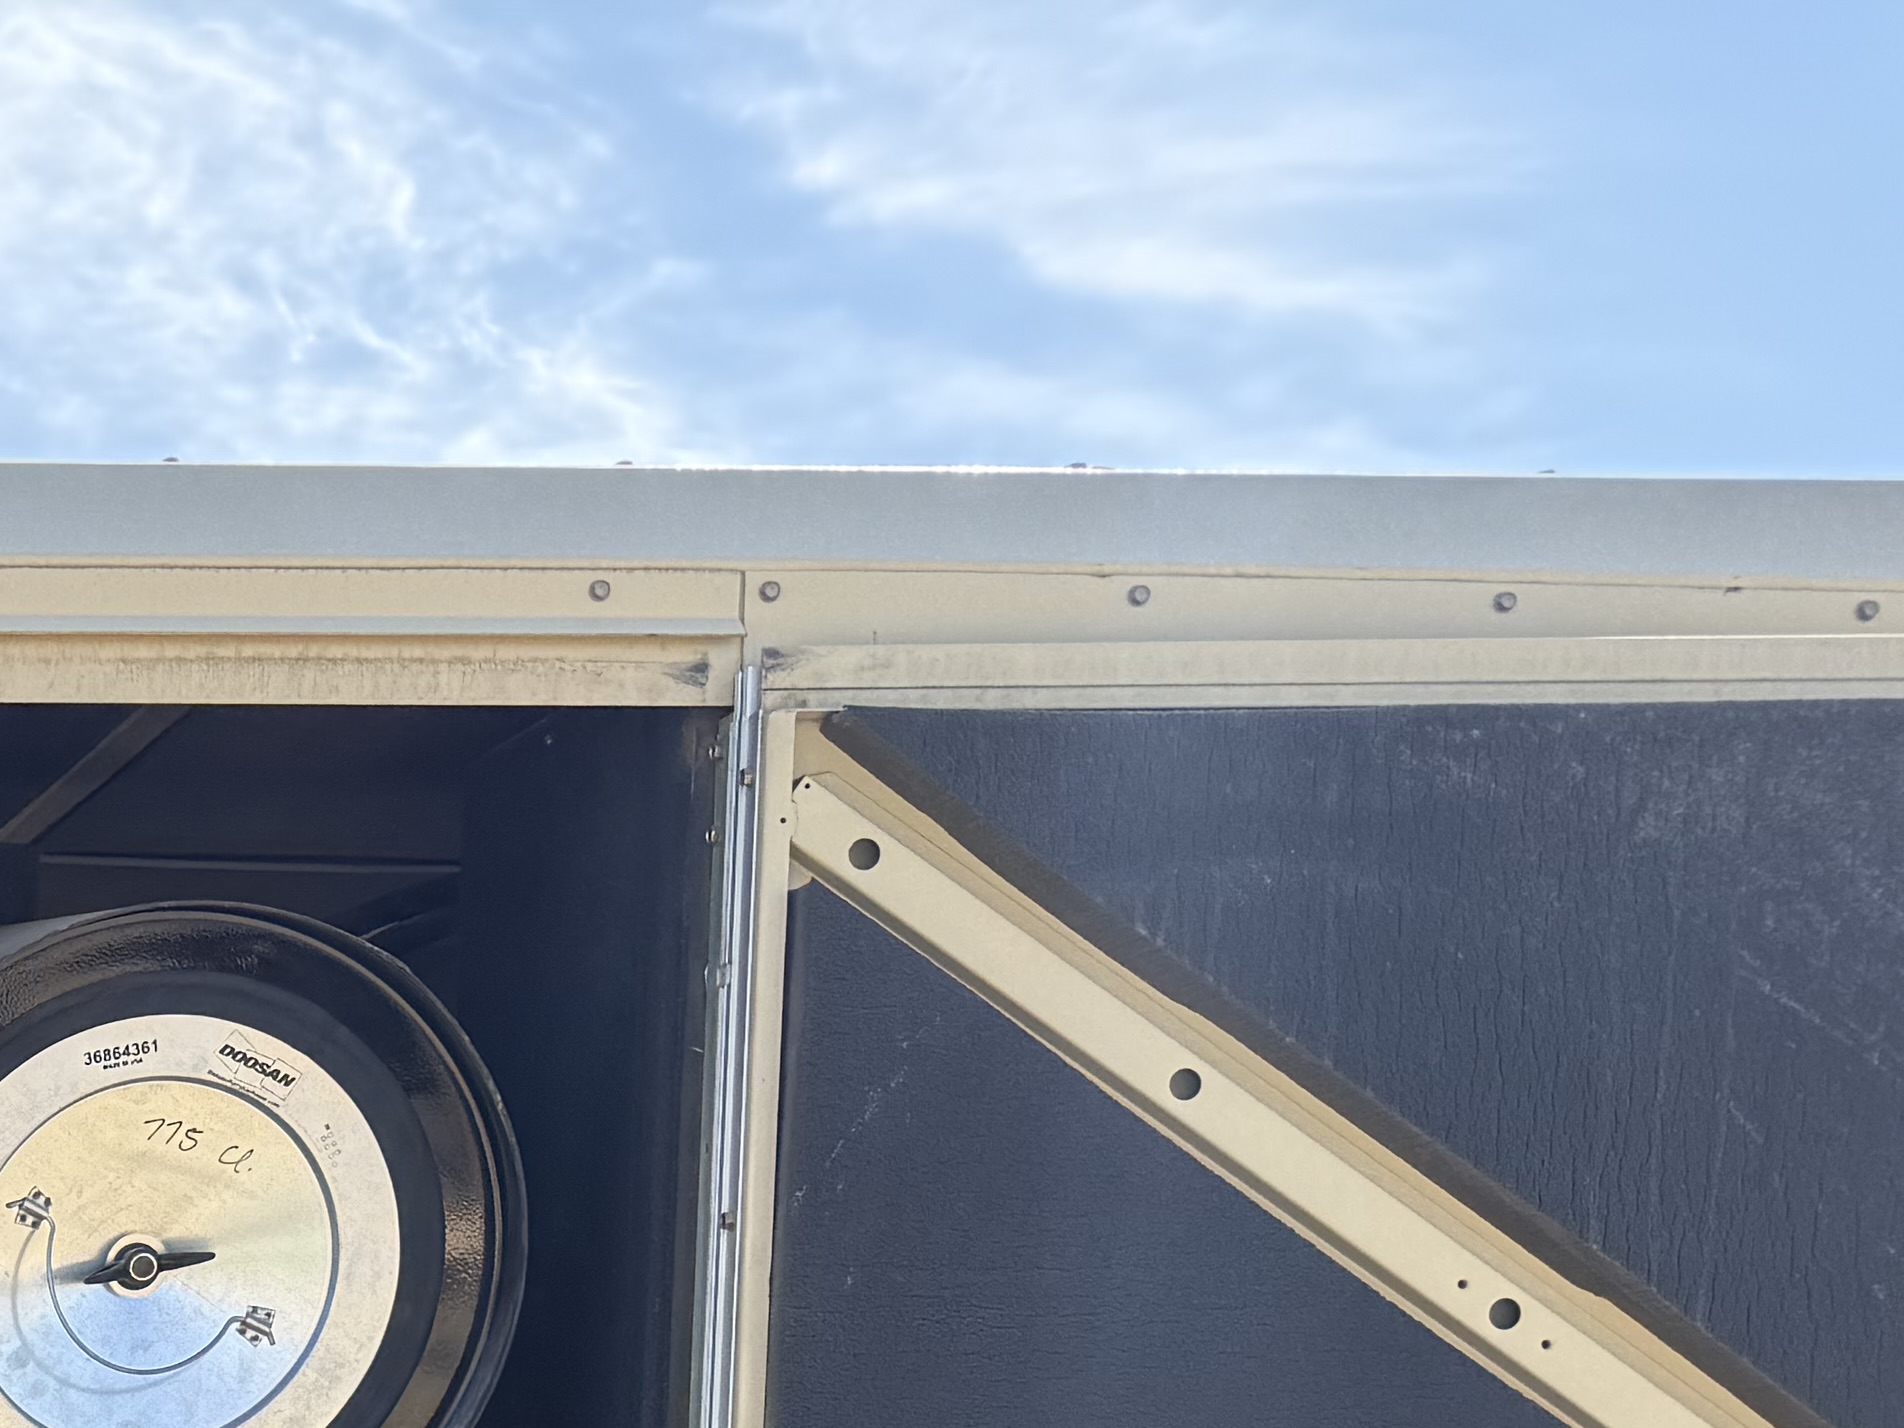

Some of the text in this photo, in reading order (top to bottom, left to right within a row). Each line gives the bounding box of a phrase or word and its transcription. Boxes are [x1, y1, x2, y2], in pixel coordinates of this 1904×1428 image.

[83, 1038, 159, 1066] 36864361
[218, 1043, 296, 1089] DOOSAN
[143, 1118, 205, 1152] 775
